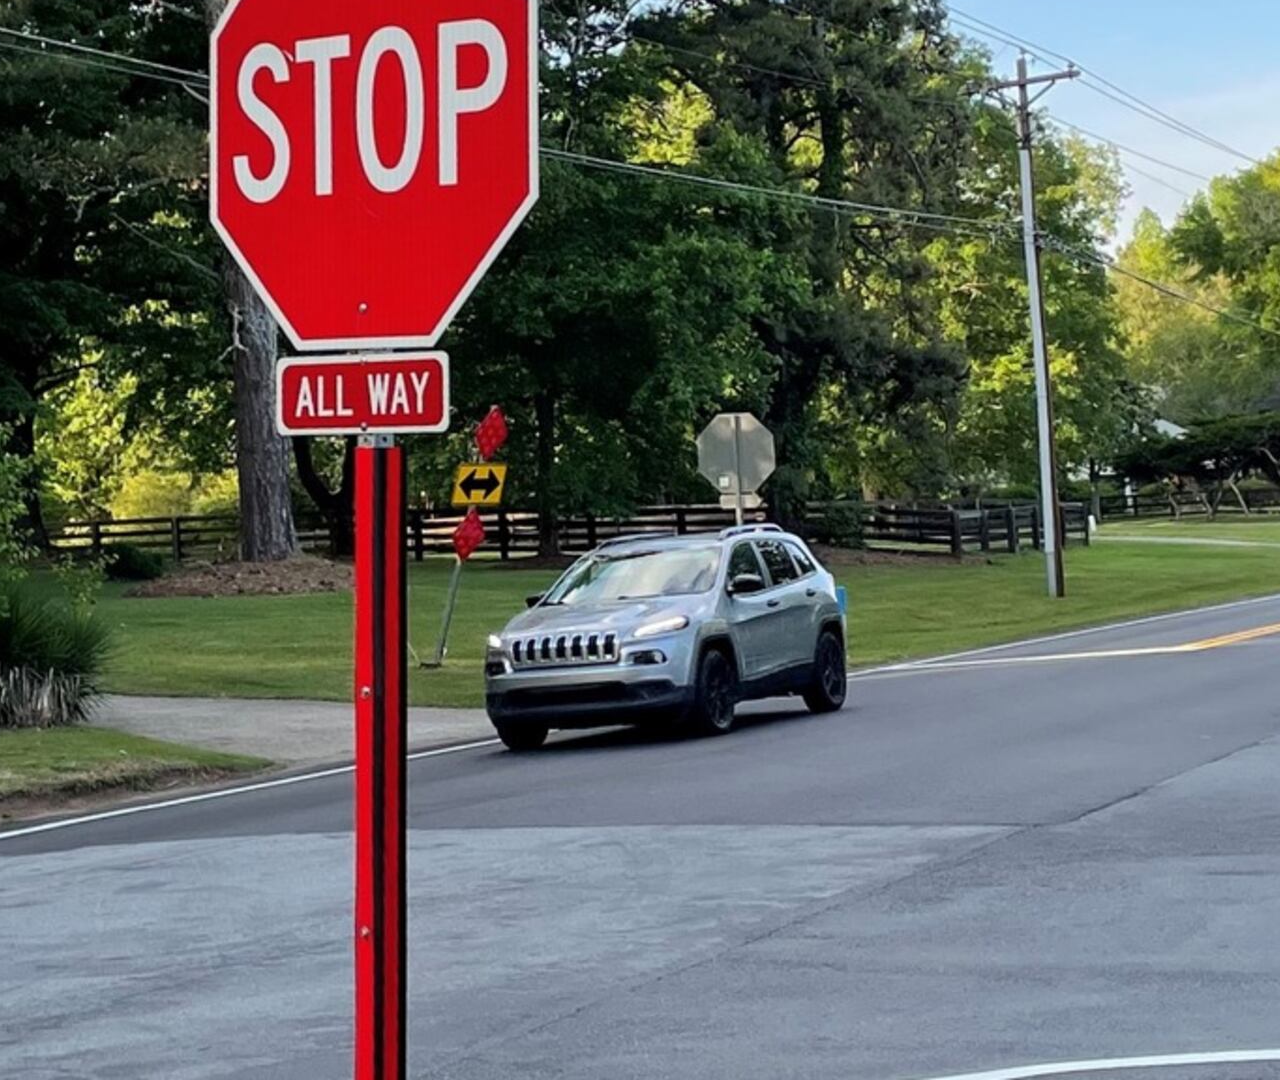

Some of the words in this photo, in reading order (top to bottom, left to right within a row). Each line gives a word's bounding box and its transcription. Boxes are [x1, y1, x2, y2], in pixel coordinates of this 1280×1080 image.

[232, 18, 508, 204] STOP
[294, 374, 354, 418] ALL
[367, 371, 431, 416] WAY
